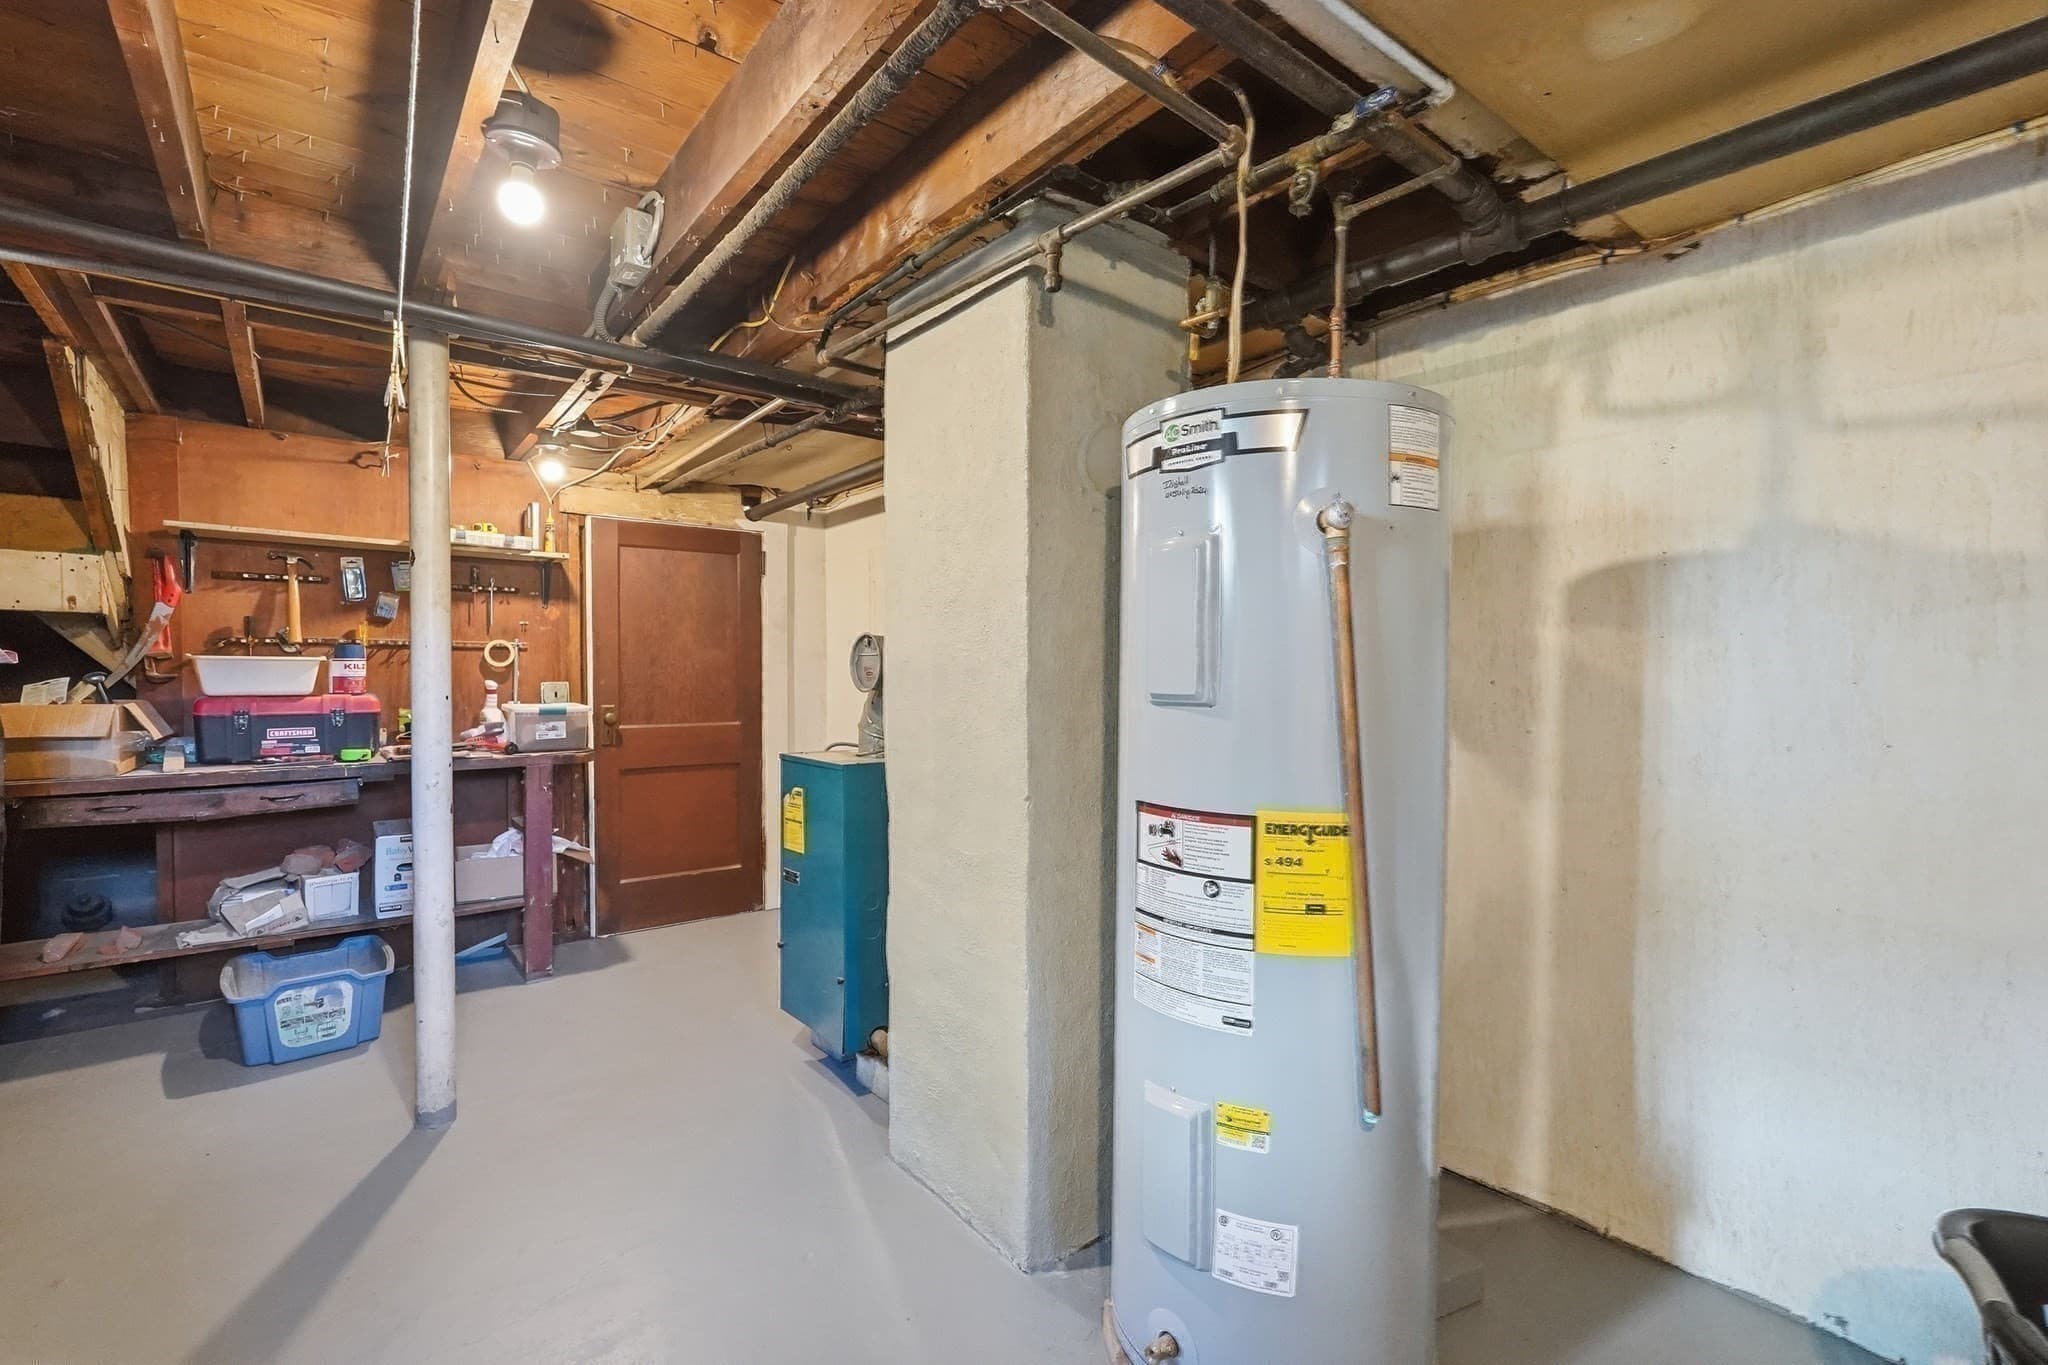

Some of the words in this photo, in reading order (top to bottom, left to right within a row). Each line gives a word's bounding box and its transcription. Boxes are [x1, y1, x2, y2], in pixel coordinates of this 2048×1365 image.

[1181, 419, 1218, 436] Smith
[269, 729, 314, 737] CRAFTSMAN
[1274, 856, 1304, 867] 494
